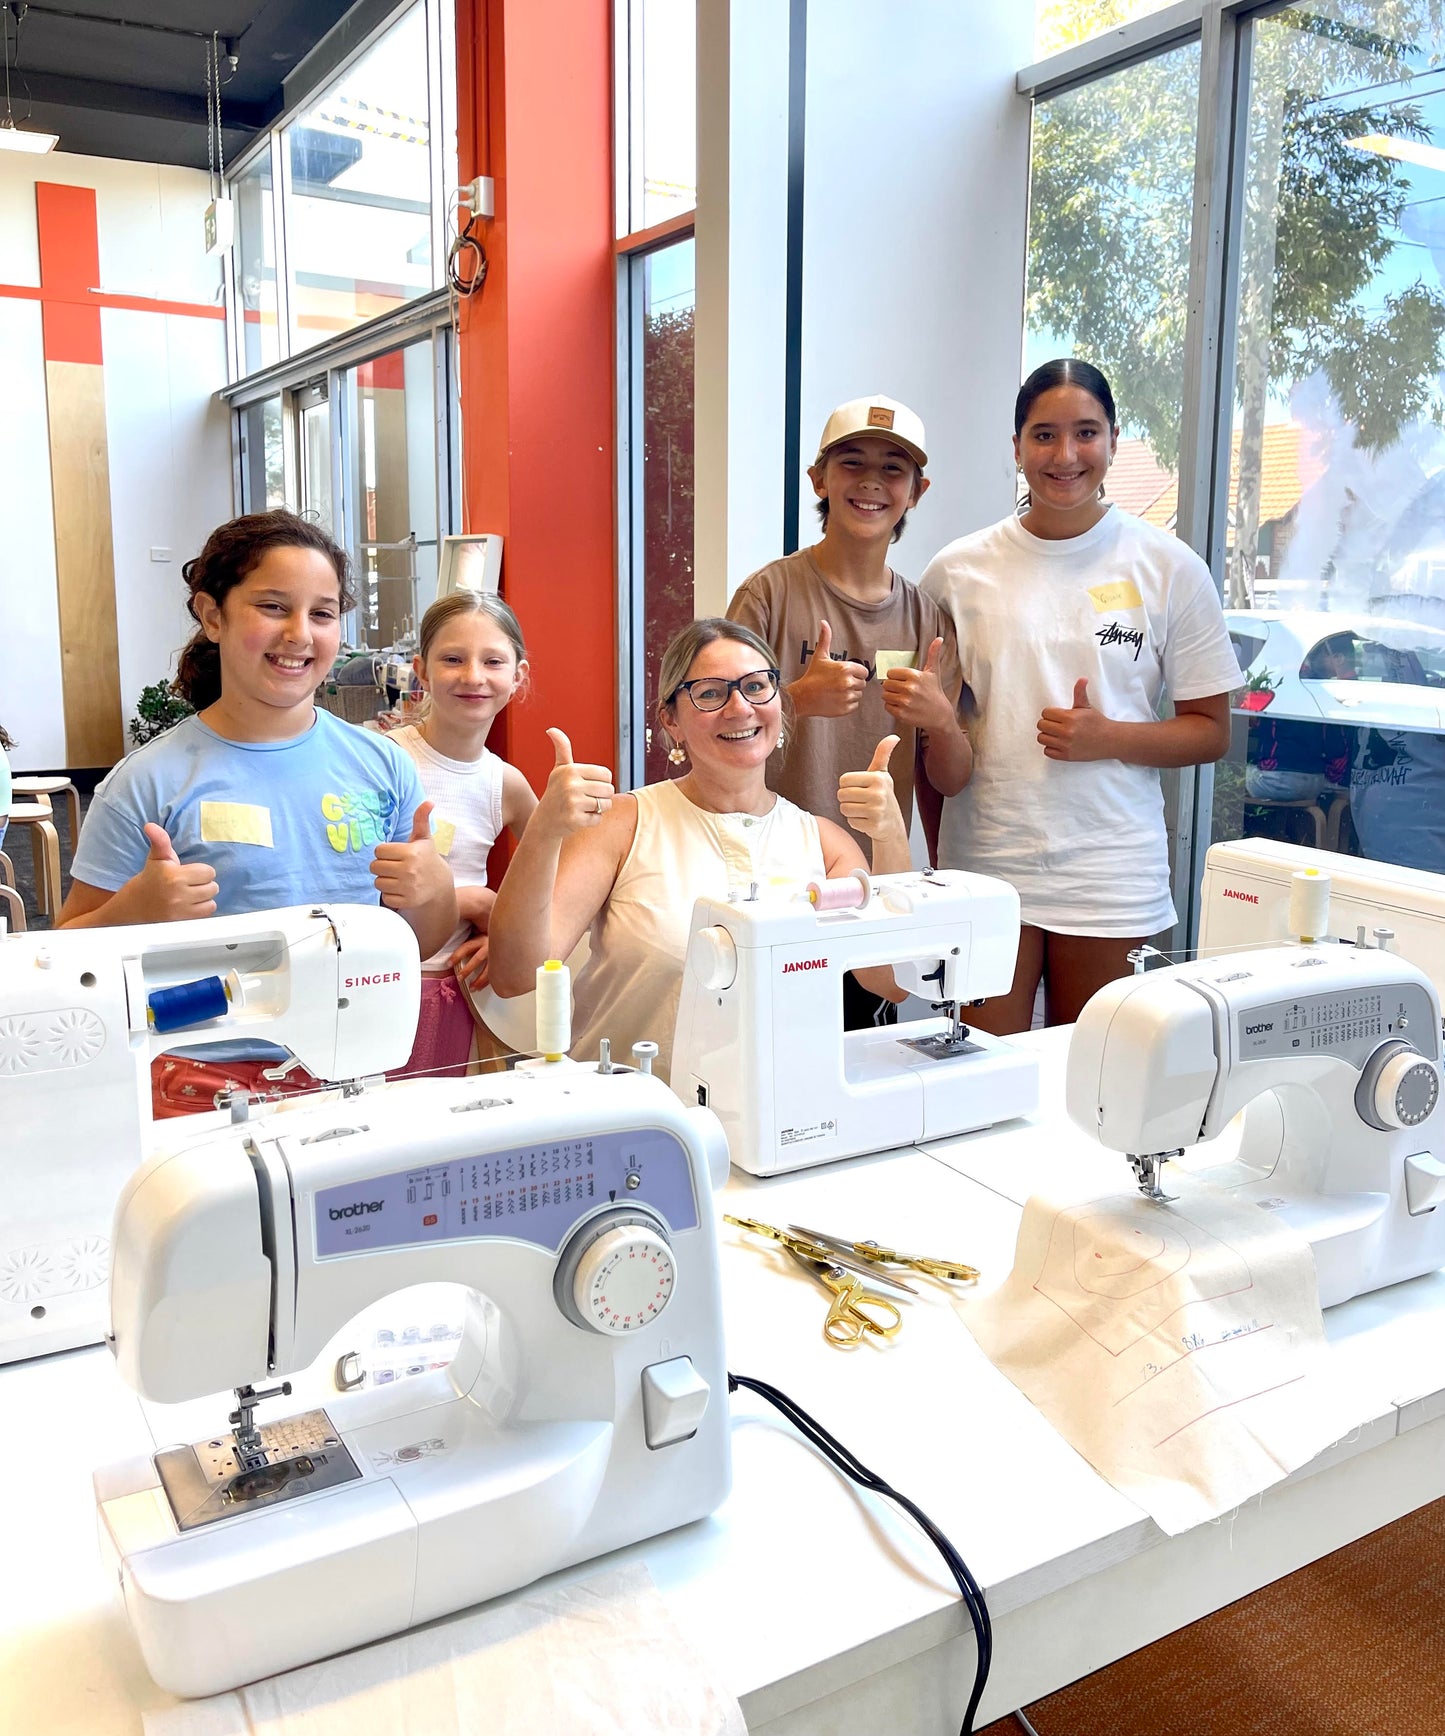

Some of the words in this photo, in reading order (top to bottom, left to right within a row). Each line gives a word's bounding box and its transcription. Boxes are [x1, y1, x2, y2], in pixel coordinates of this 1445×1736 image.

[1223, 888, 1259, 904] JANOME
[782, 958, 828, 974] JANOME
[345, 972, 401, 988] SINGER
[1246, 1023, 1274, 1035] brother
[329, 1199, 385, 1221] brother
